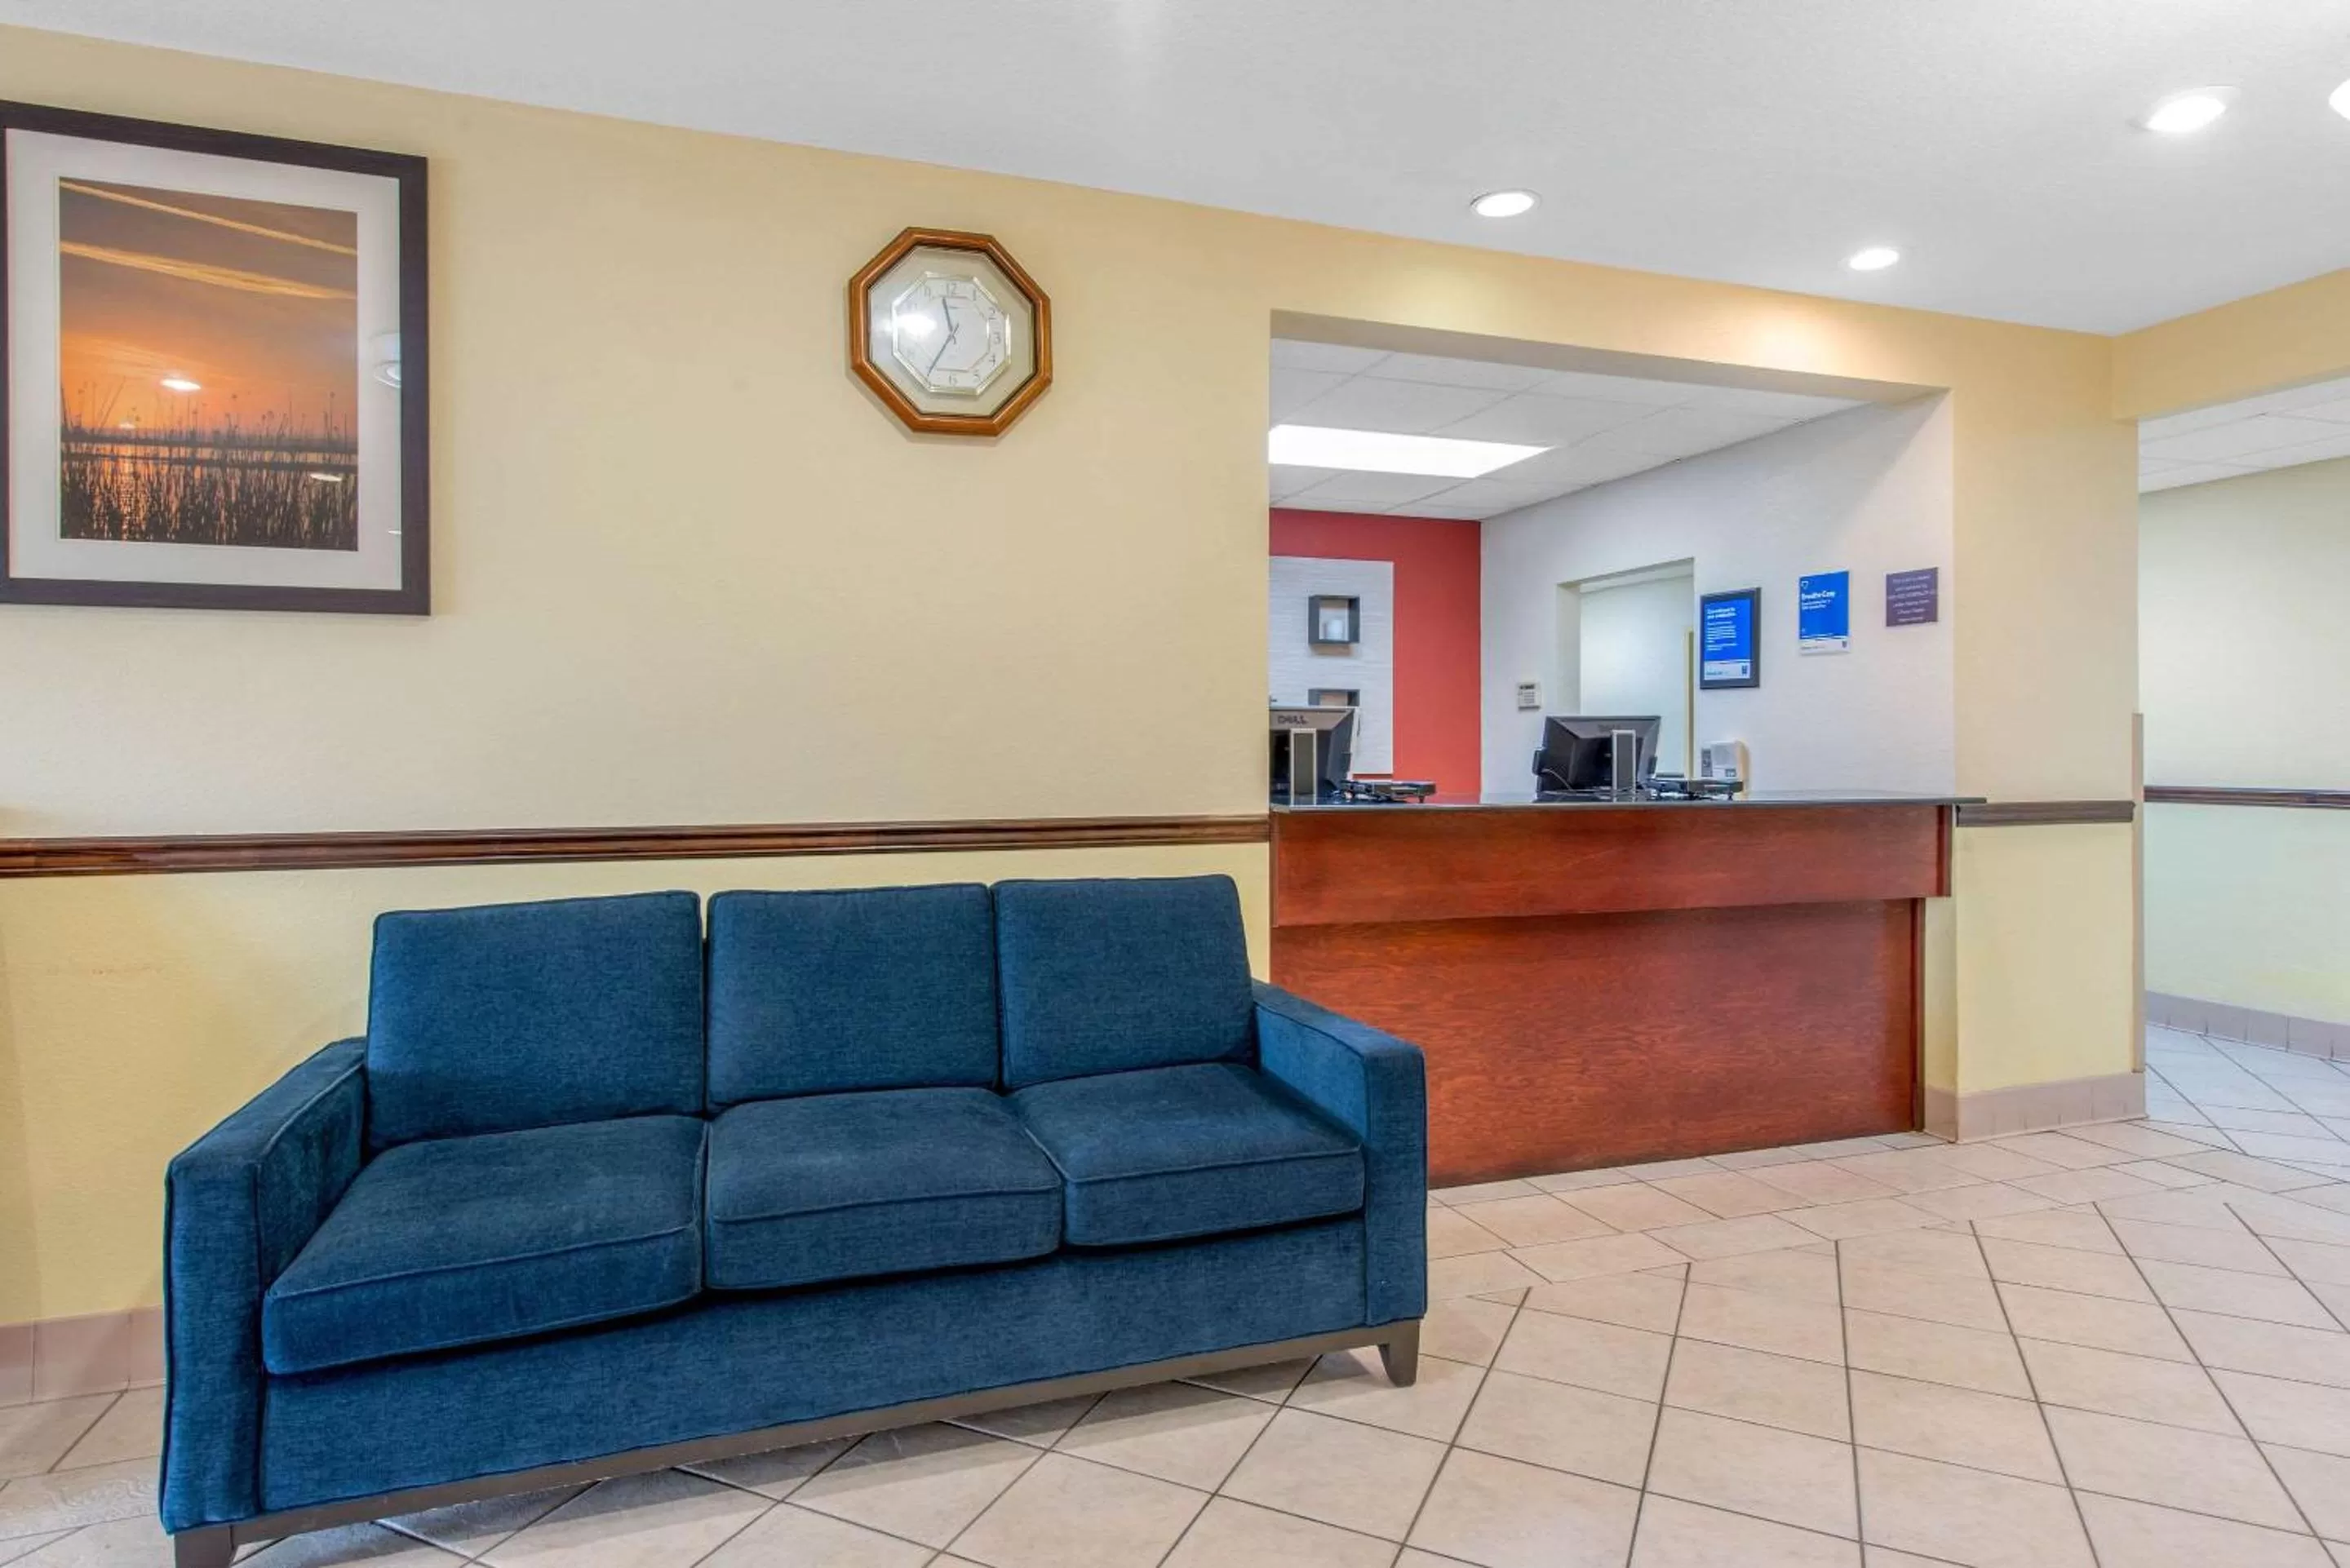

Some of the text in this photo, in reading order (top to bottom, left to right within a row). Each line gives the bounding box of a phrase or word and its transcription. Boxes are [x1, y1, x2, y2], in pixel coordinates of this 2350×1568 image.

[946, 282, 957, 295] 12
[988, 307, 996, 321] 2
[992, 331, 1002, 344] 3
[1278, 715, 1309, 724] DELL
